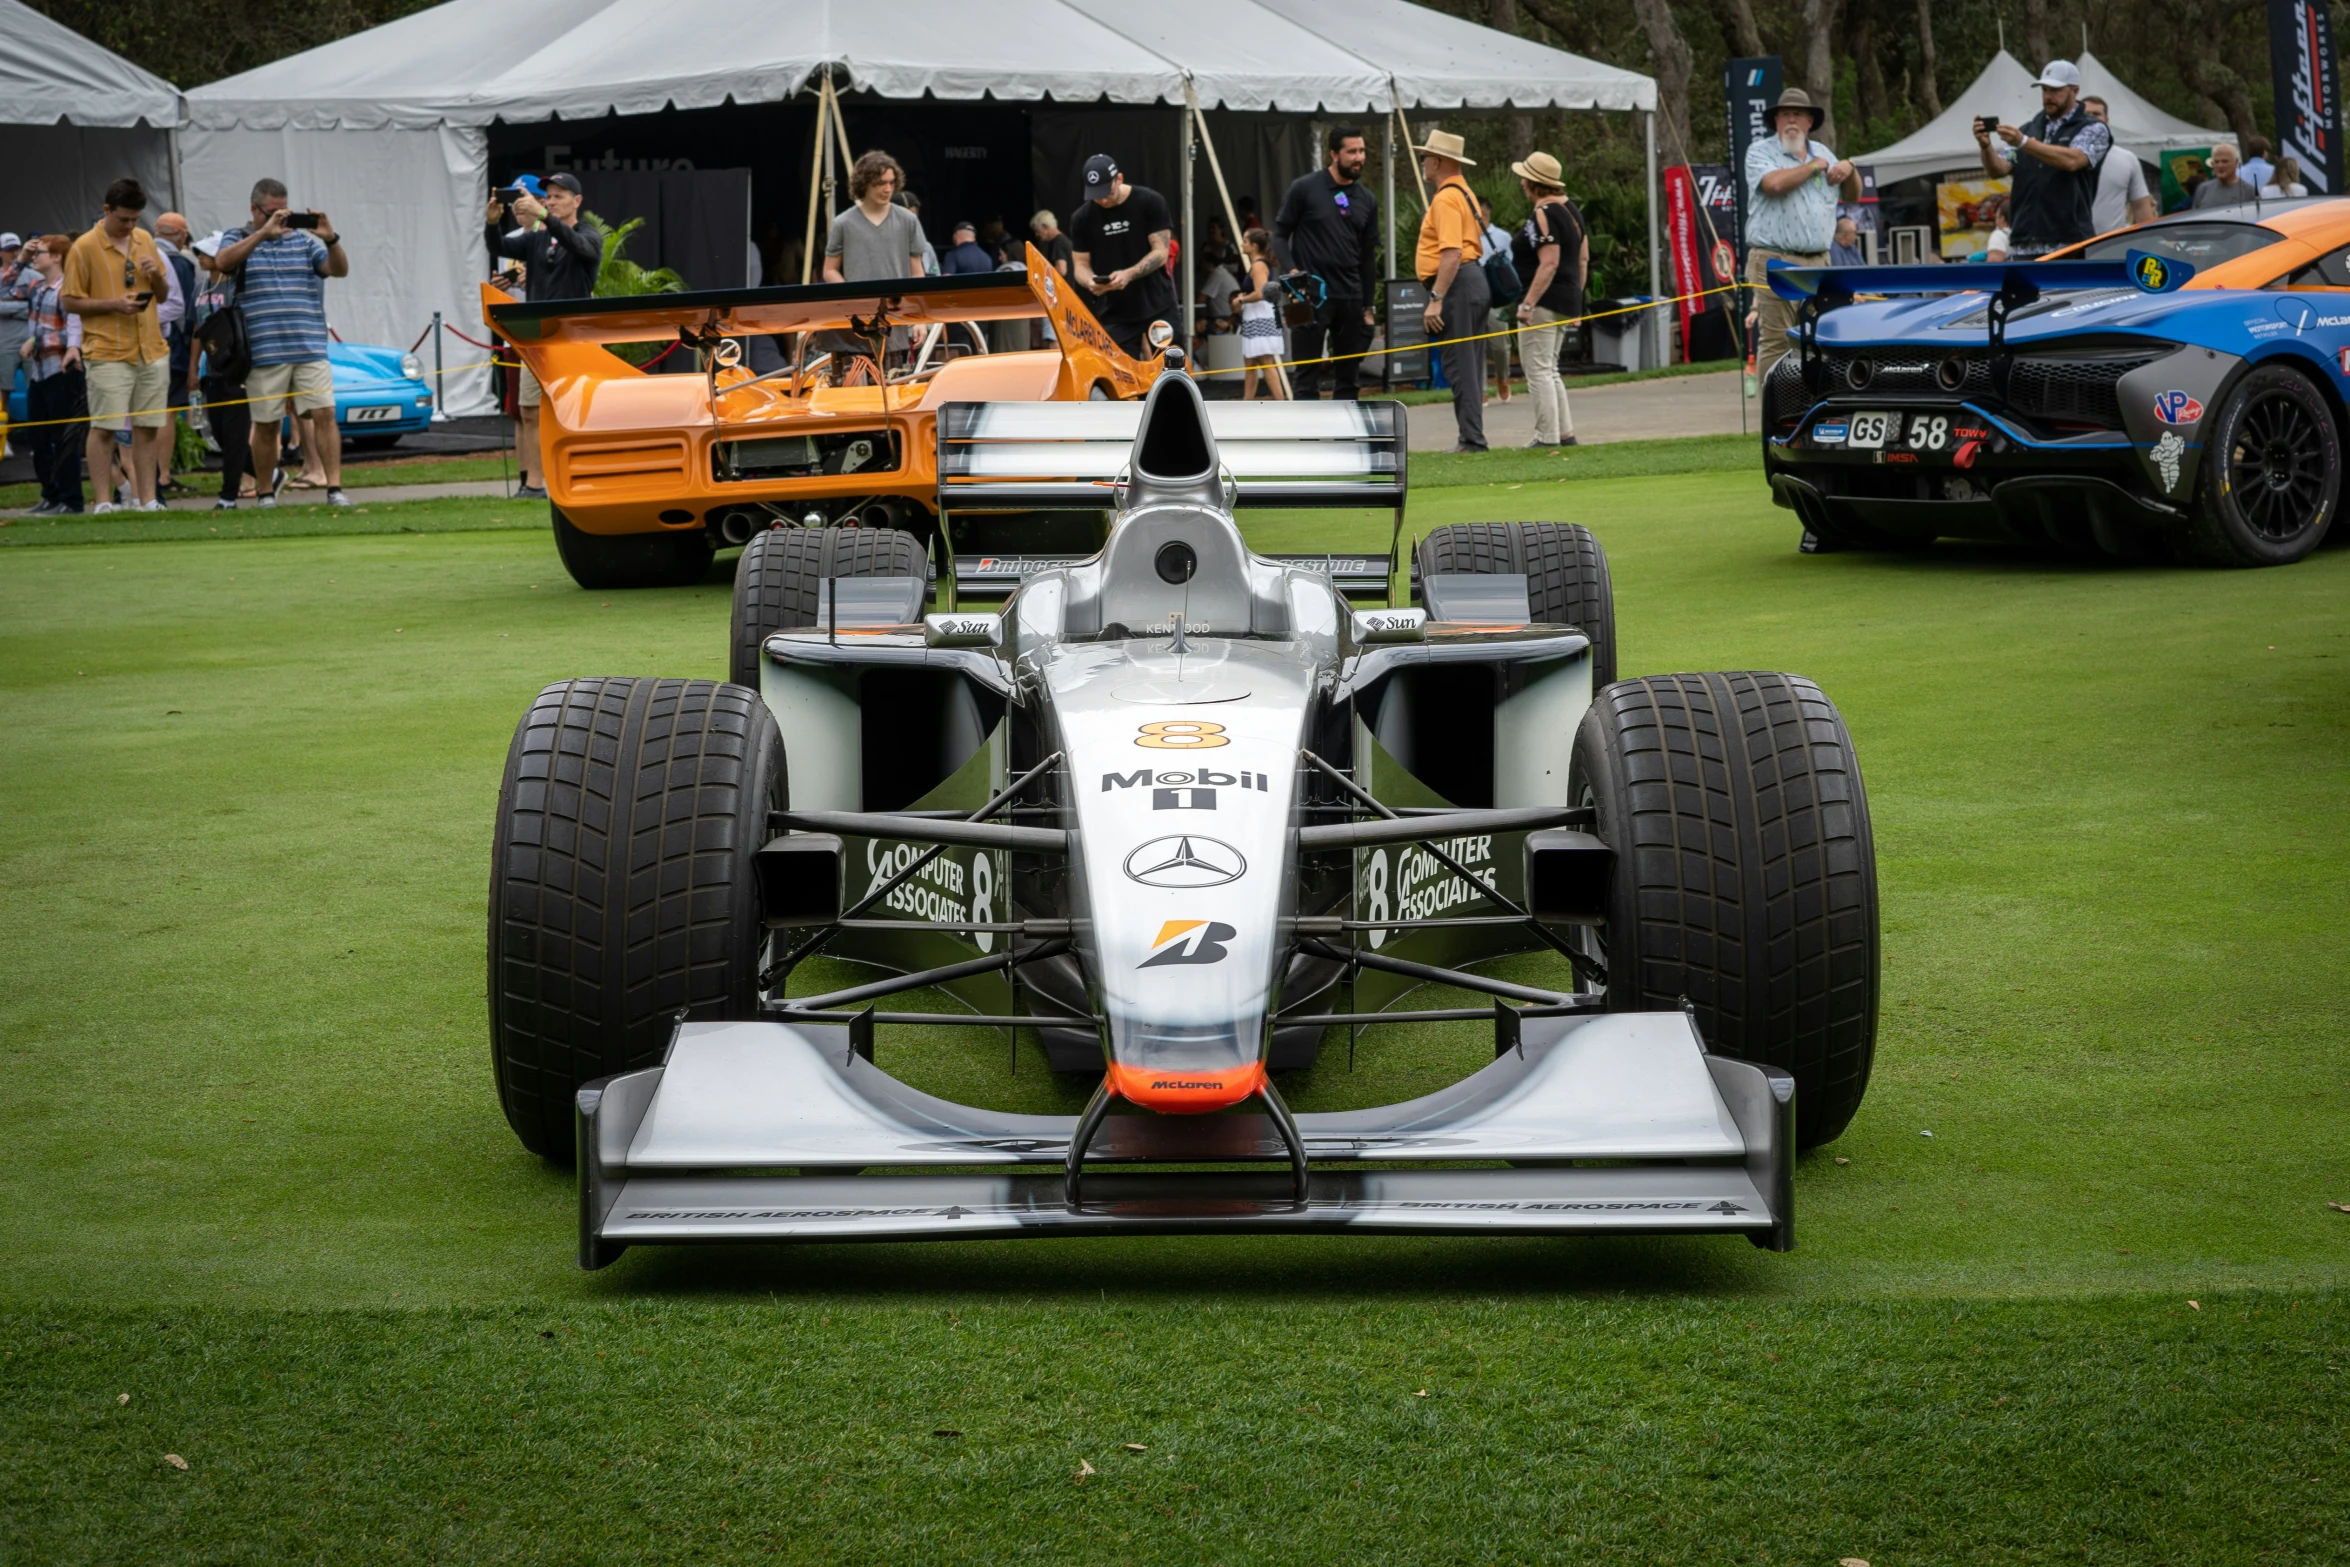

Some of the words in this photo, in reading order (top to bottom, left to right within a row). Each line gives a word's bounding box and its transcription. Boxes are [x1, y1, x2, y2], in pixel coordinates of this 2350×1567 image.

[2316, 13, 2333, 130] MOTORWORKS
[944, 146, 988, 159] HAGERTY
[1880, 365, 1923, 375] McLaren
[2155, 390, 2188, 424] VP
[1853, 417, 1885, 442] GS
[1908, 416, 1948, 450] 58
[1887, 453, 1919, 463] IMSA
[957, 620, 990, 634] Sun
[1146, 623, 1211, 634] KENOOD
[1386, 616, 1417, 630] Sun
[1134, 720, 1231, 750] 8
[1101, 768, 1268, 793] Mobil
[973, 852, 993, 953] 8
[1369, 849, 1389, 949] 8
[1151, 1081, 1223, 1090] McLaren
[1398, 1202, 1521, 1210] BRITISH
[1522, 1201, 1702, 1210] AEROSPACE
[625, 1211, 748, 1220] BRITISH
[751, 1207, 932, 1219] AEROSPACE
